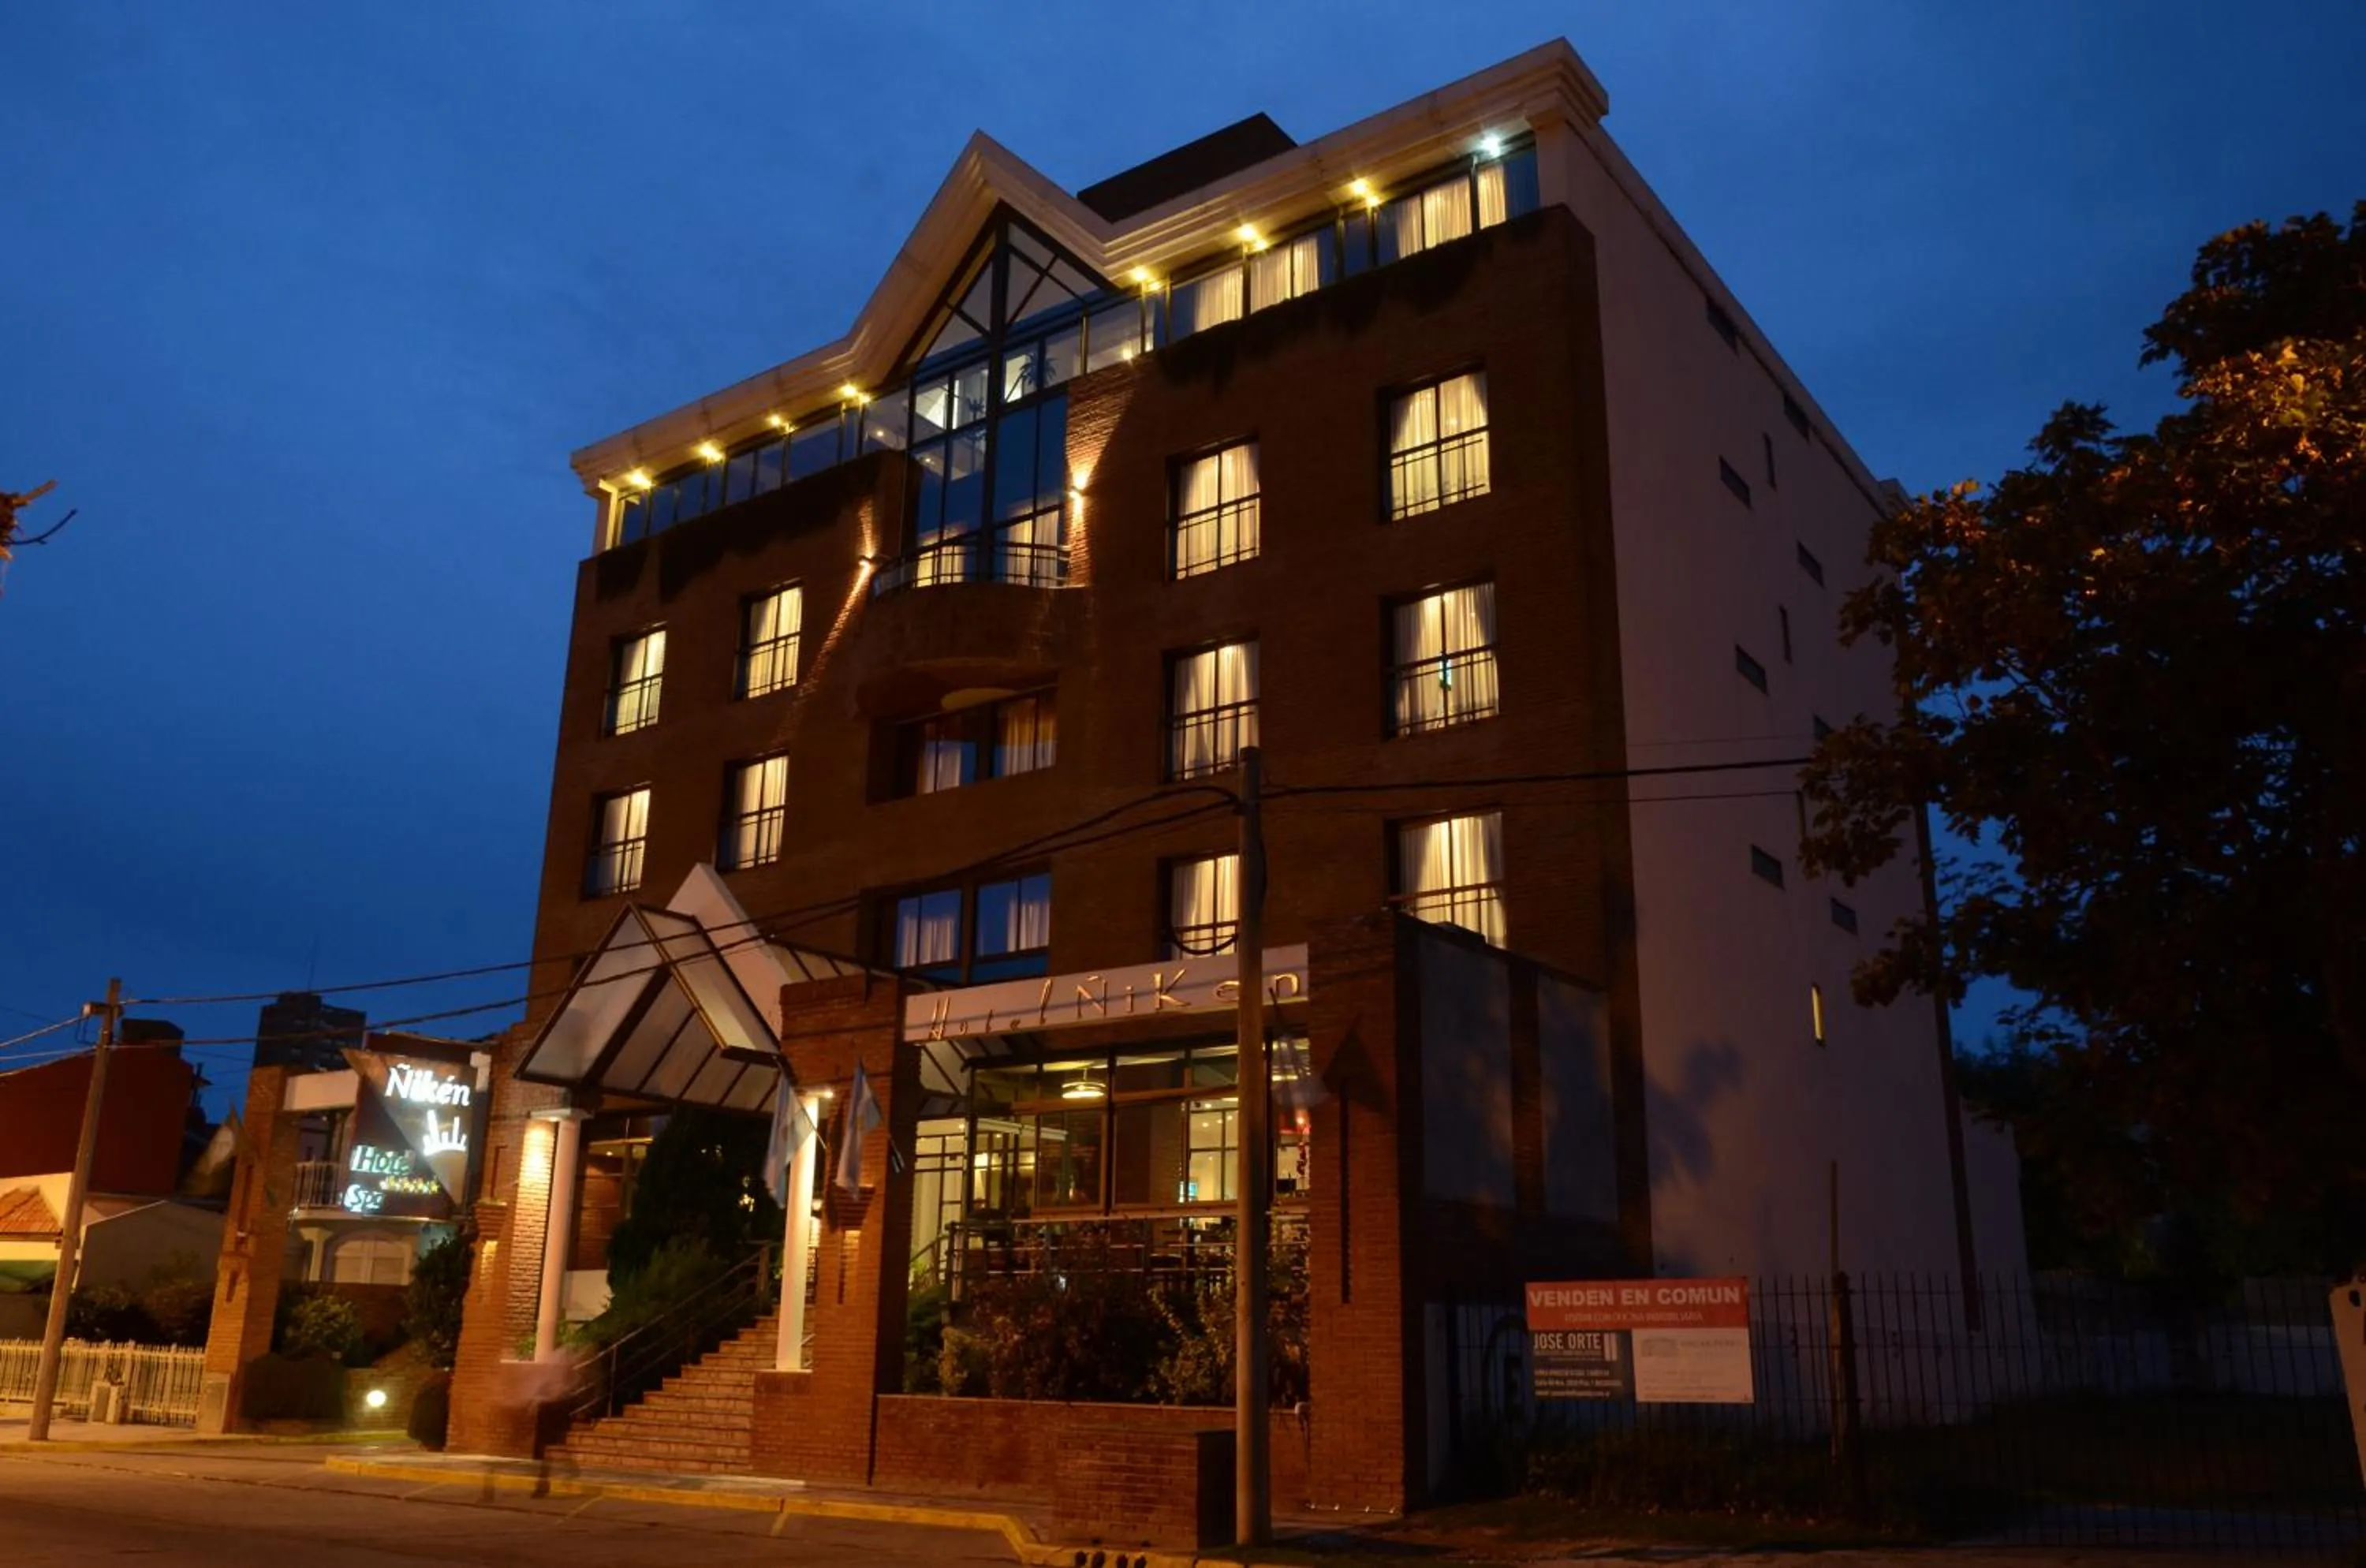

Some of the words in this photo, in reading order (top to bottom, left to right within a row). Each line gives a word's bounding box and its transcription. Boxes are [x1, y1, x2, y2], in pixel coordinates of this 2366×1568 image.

[1528, 1288, 1614, 1308] VENDEN
[1621, 1287, 1650, 1306] EN
[1656, 1286, 1741, 1305] COMUN
[1533, 1332, 1564, 1350] JOSE
